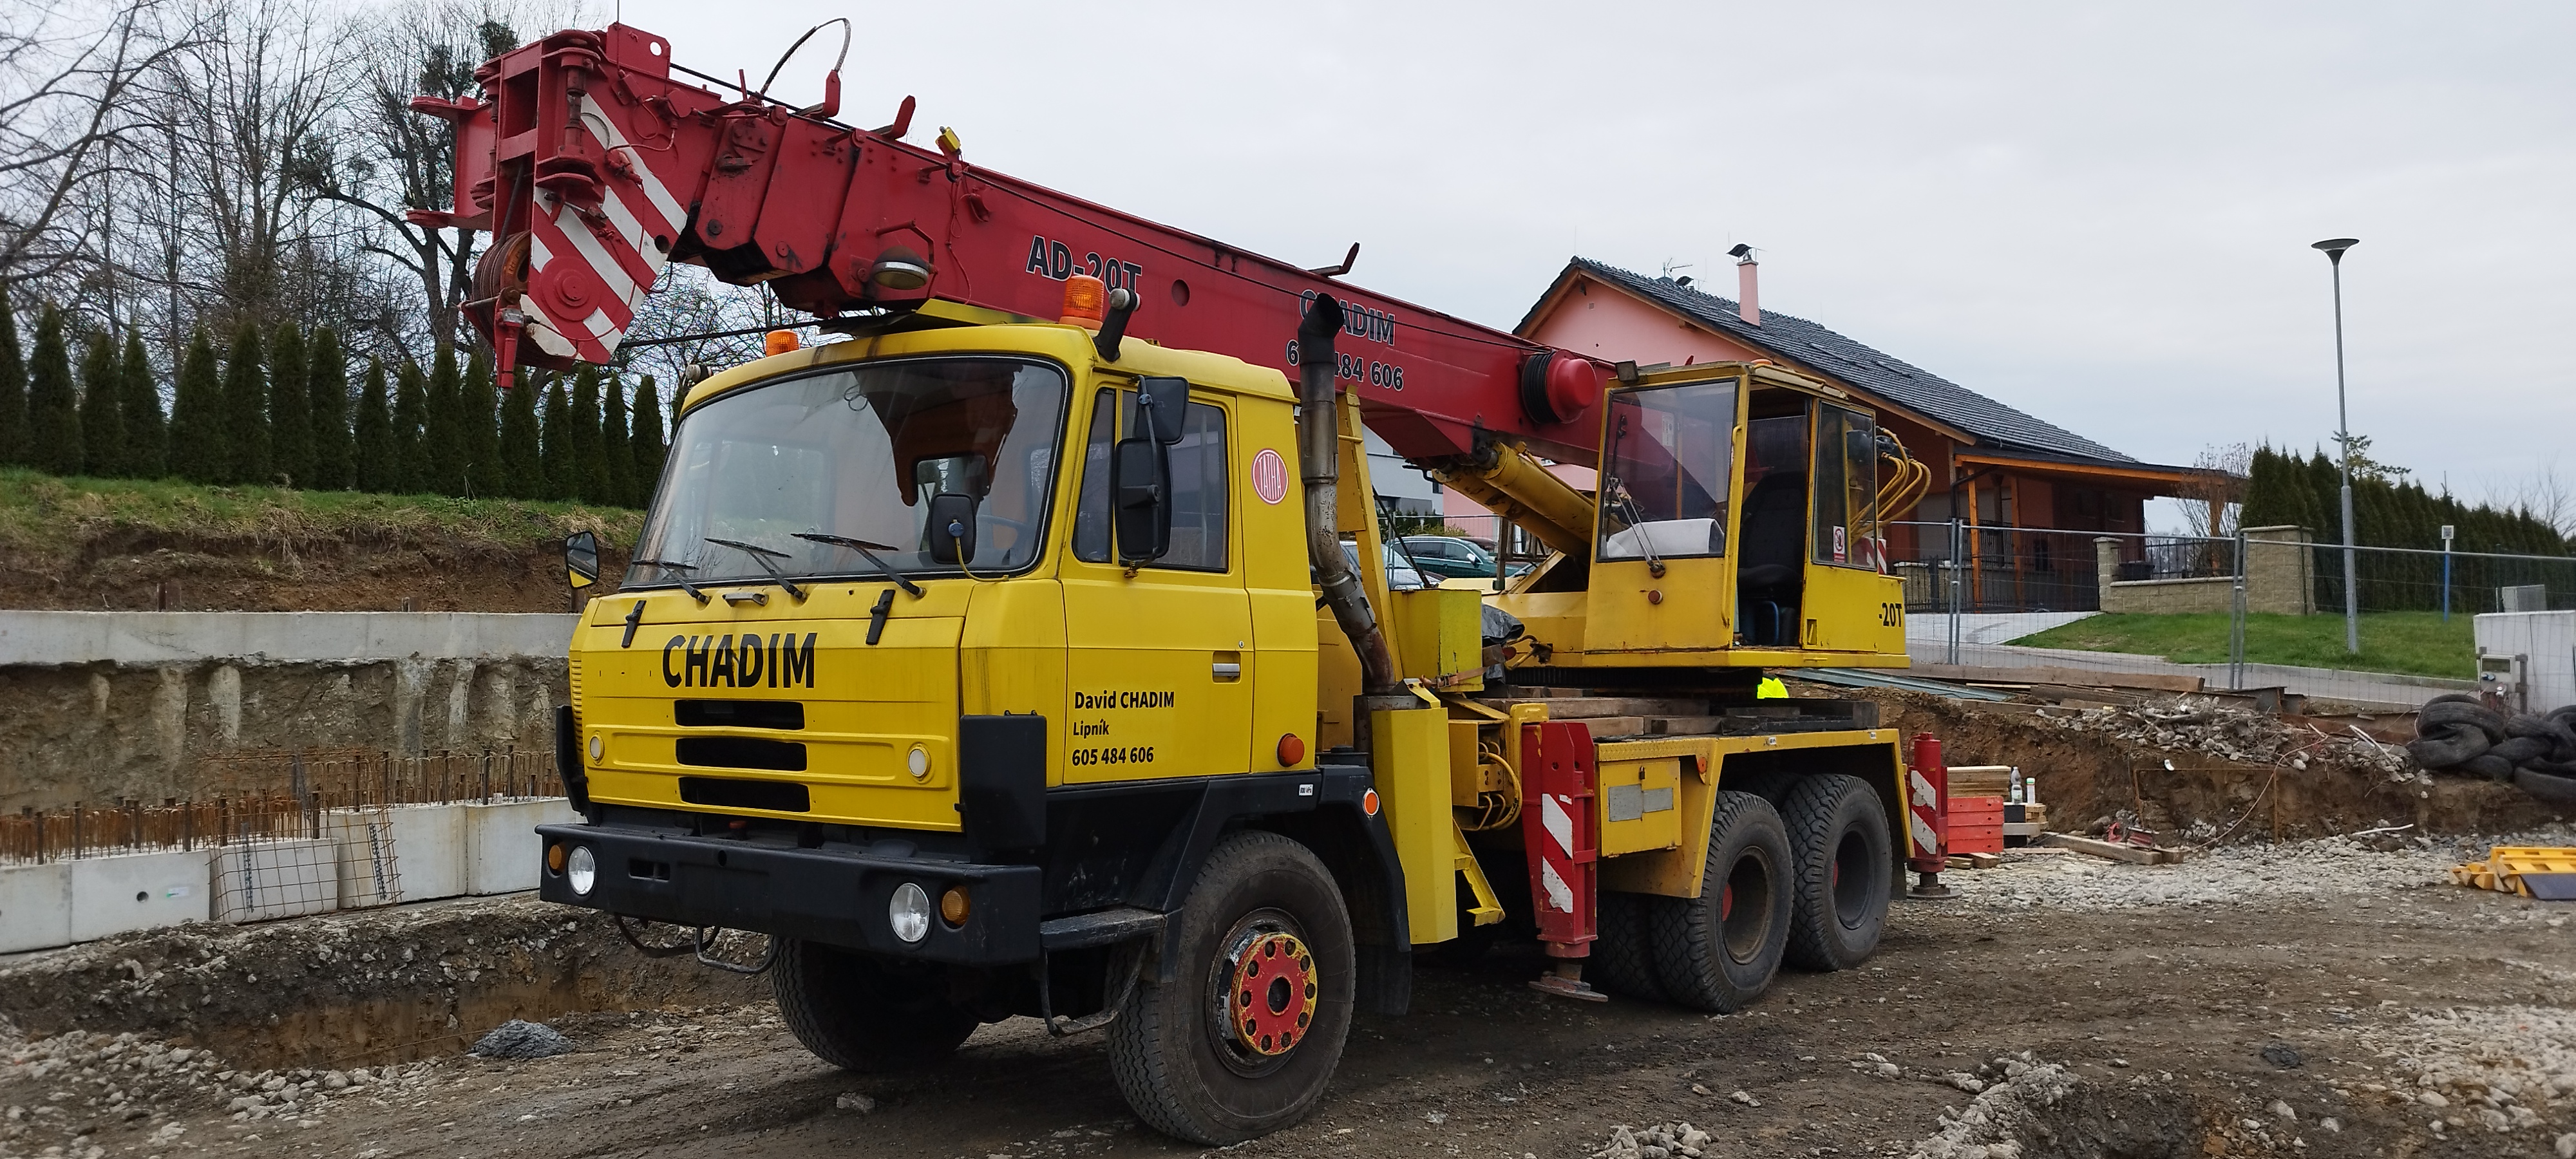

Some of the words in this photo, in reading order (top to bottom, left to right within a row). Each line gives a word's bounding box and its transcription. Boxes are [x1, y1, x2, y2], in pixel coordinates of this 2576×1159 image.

[1026, 235, 1142, 294] AD-20T
[1300, 289, 1395, 346] CADIM
[1370, 361, 1403, 391] 606
[1258, 453, 1282, 500] TATRA
[1879, 602, 1902, 628] -20T
[662, 632, 818, 689] CHADIM
[1074, 690, 1117, 709] David
[1120, 691, 1175, 709] CHADIM
[1072, 718, 1110, 739] Lipník
[1072, 749, 1098, 766] 605
[1101, 748, 1126, 764] 484
[1130, 746, 1155, 764] 606
